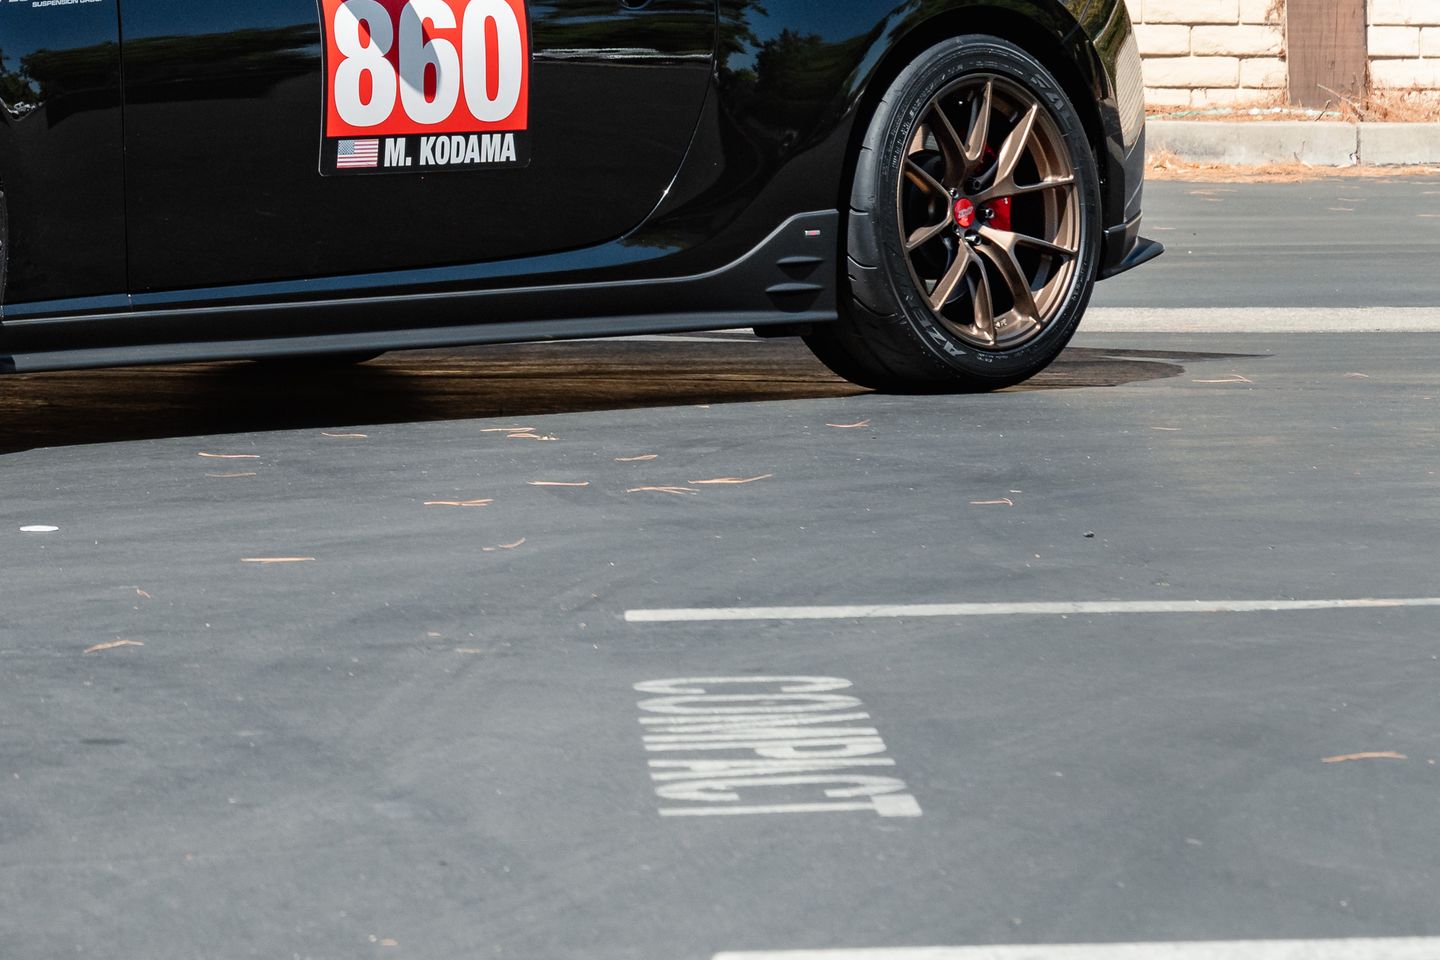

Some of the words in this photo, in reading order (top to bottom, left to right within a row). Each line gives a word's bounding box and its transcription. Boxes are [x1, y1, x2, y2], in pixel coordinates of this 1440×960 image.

[384, 138, 412, 167] M.
[419, 133, 517, 165] KODAMA
[632, 675, 923, 817] COMPACT
